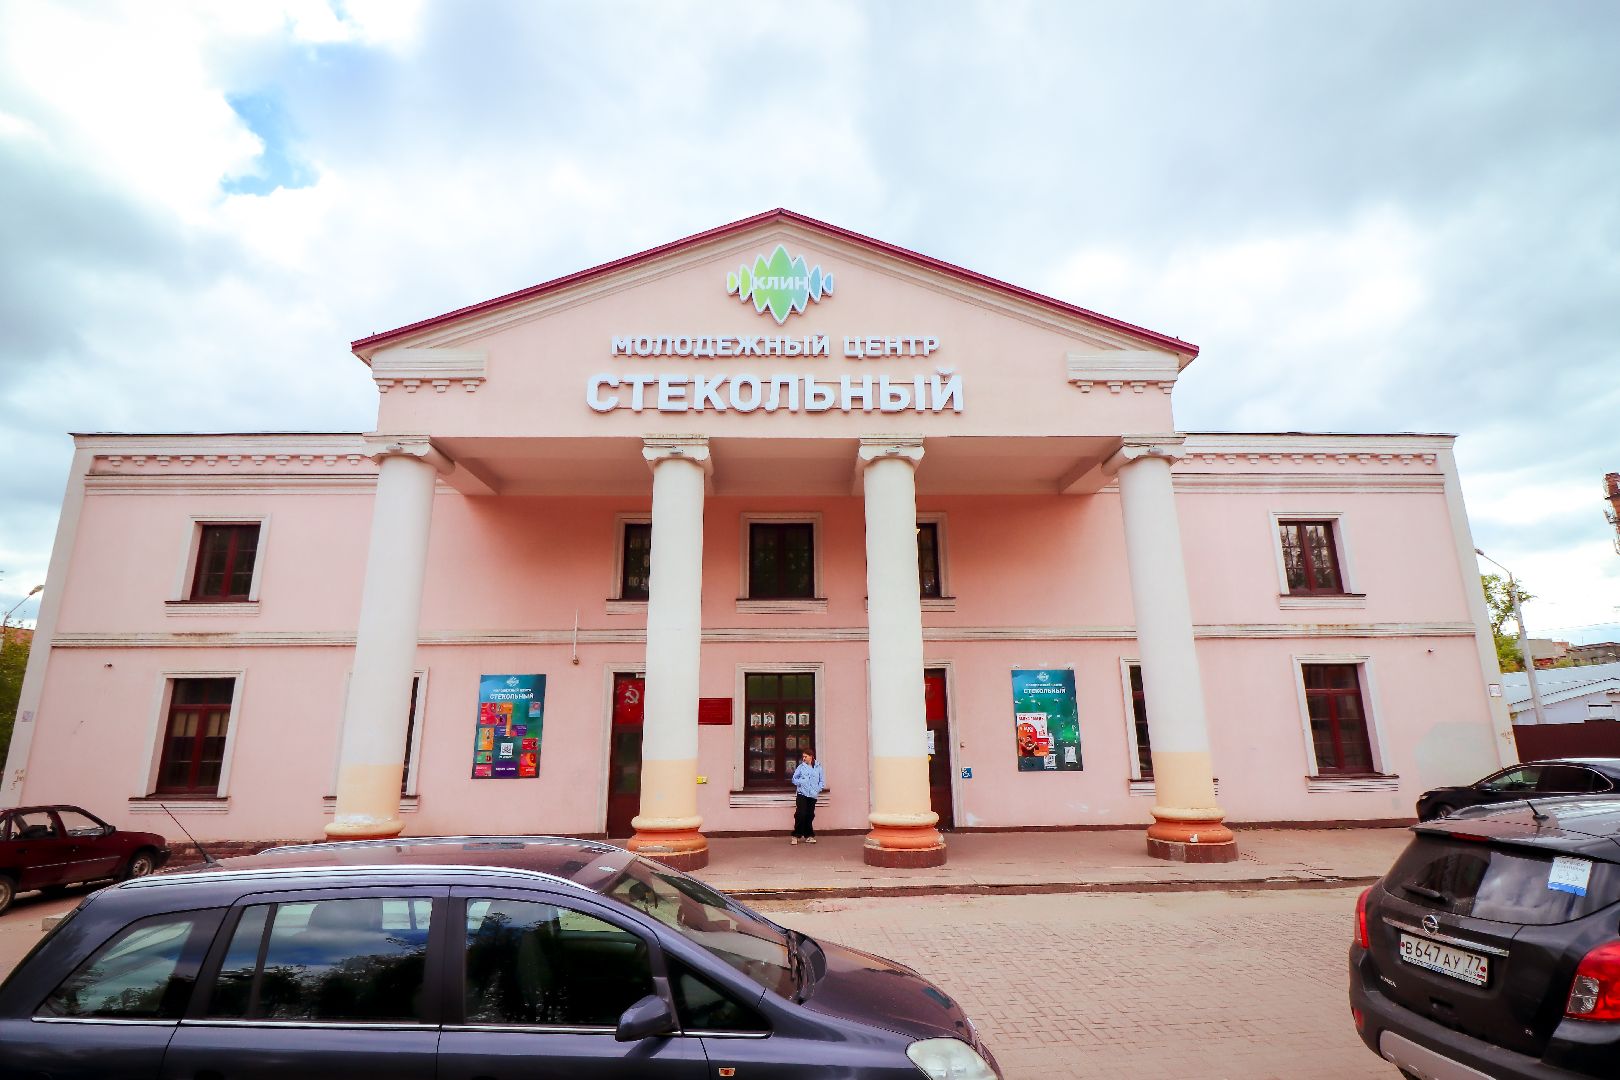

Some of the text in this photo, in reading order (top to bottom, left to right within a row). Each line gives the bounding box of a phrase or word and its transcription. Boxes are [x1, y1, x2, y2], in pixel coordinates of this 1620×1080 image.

[753, 276, 808, 290] КЛИН
[610, 334, 941, 360] МОЛОДЕЖНЫЙ ЦЕНТР
[586, 366, 964, 413] СТЕКОЛЬНЫЙ
